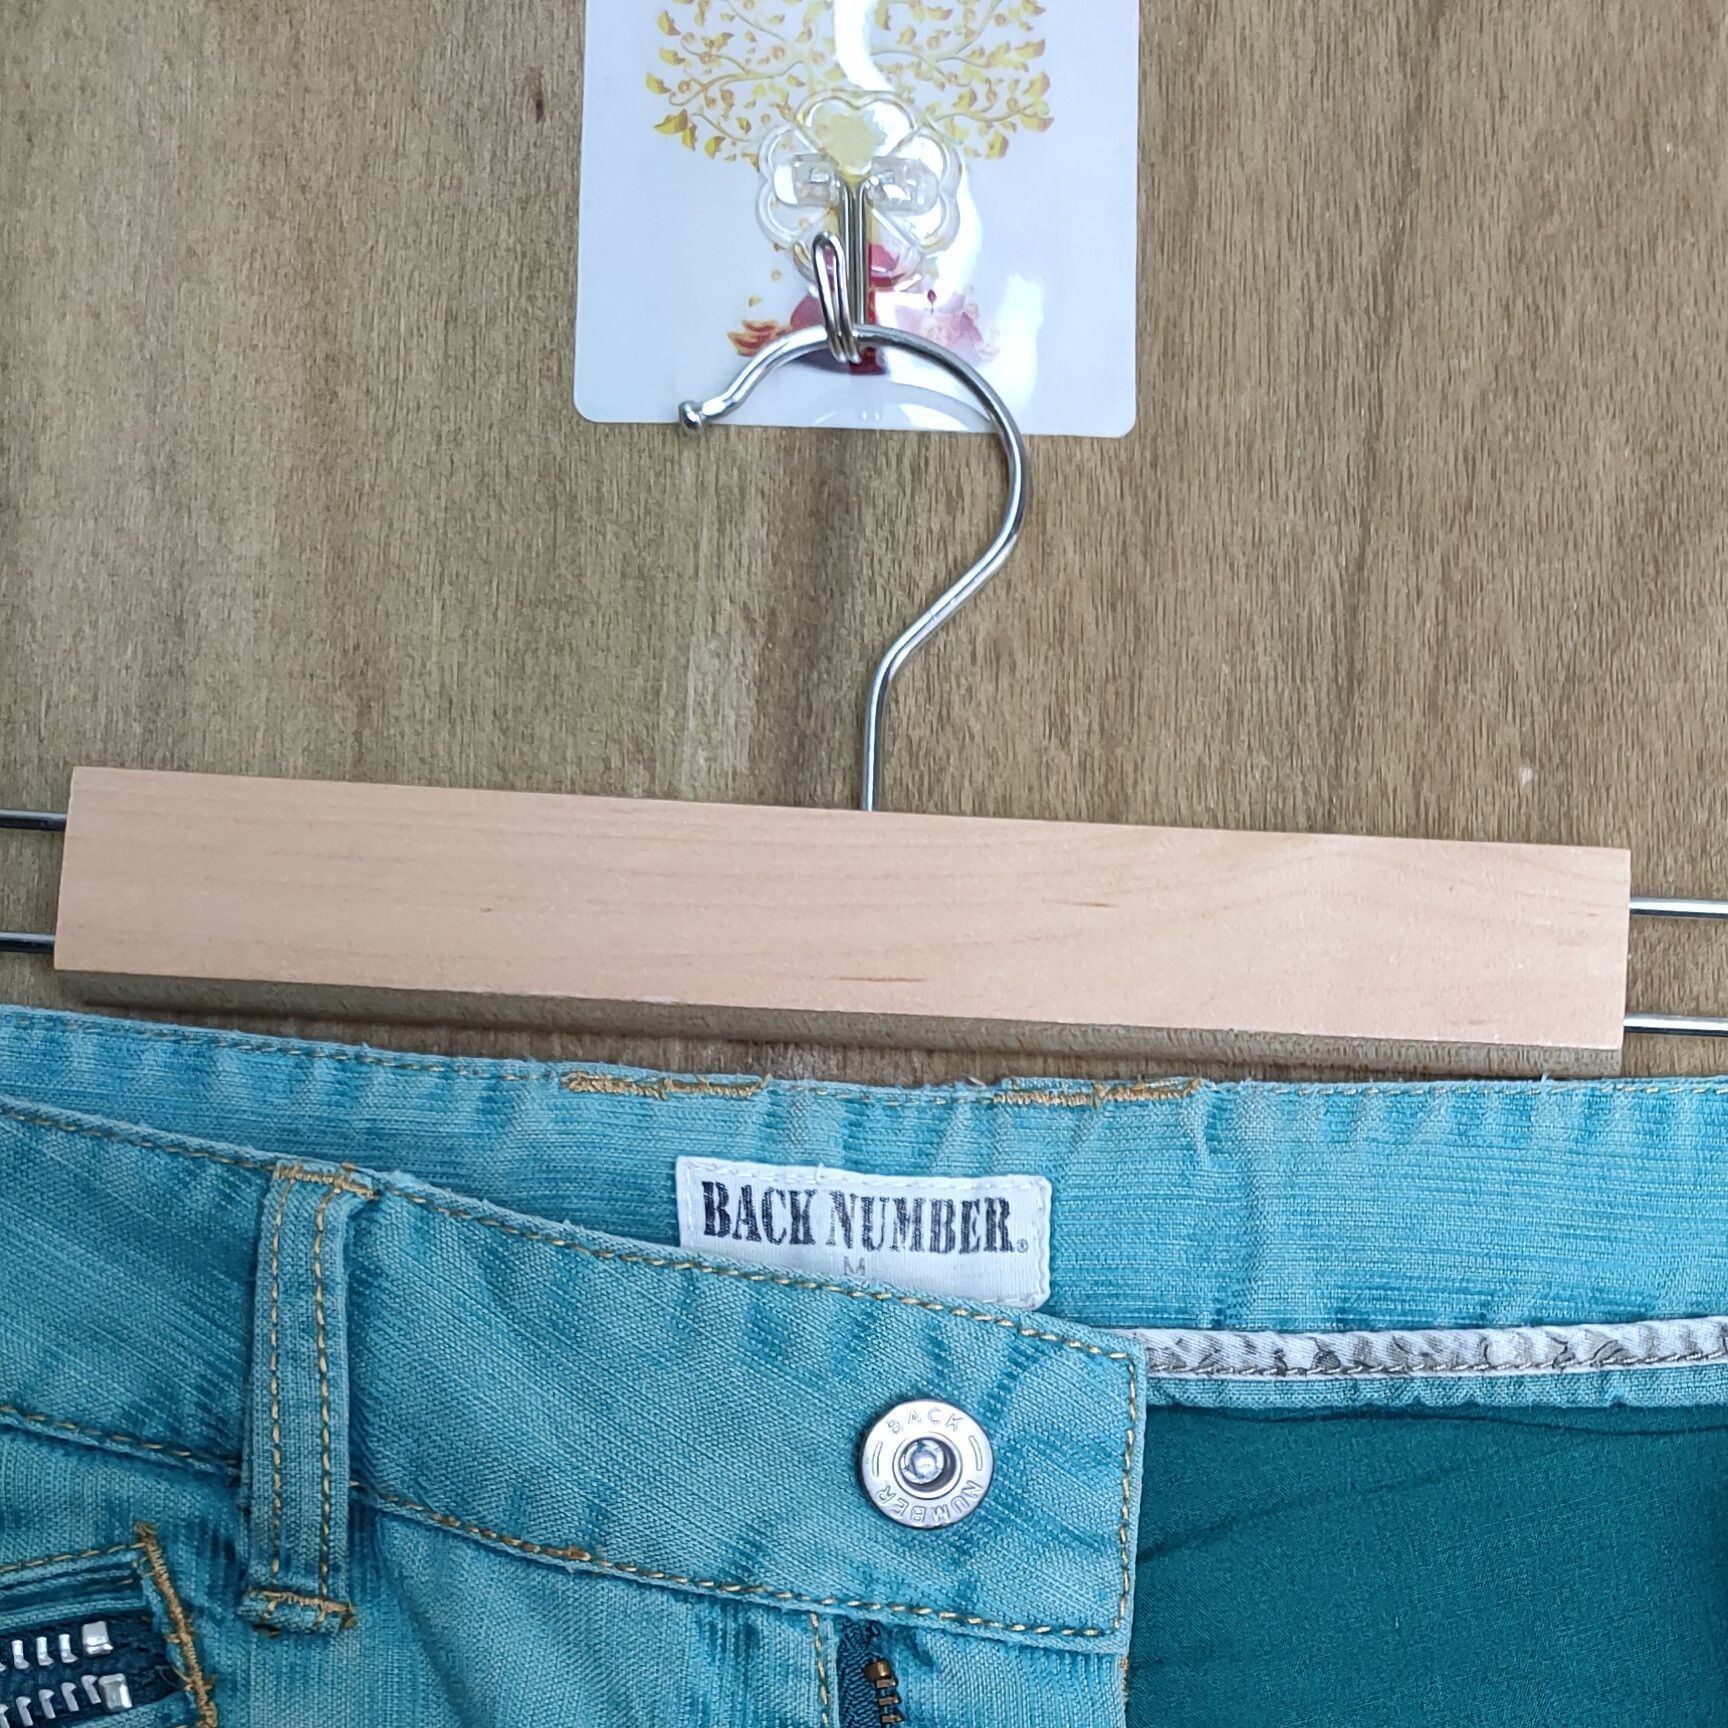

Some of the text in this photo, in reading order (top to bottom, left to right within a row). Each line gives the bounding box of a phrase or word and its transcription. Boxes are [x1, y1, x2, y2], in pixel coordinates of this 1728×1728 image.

[702, 1180, 1015, 1254] BACK NUMBER
[843, 1255, 866, 1277] M
[885, 1406, 964, 1435] BACK
[877, 1479, 984, 1523] NUMBER
